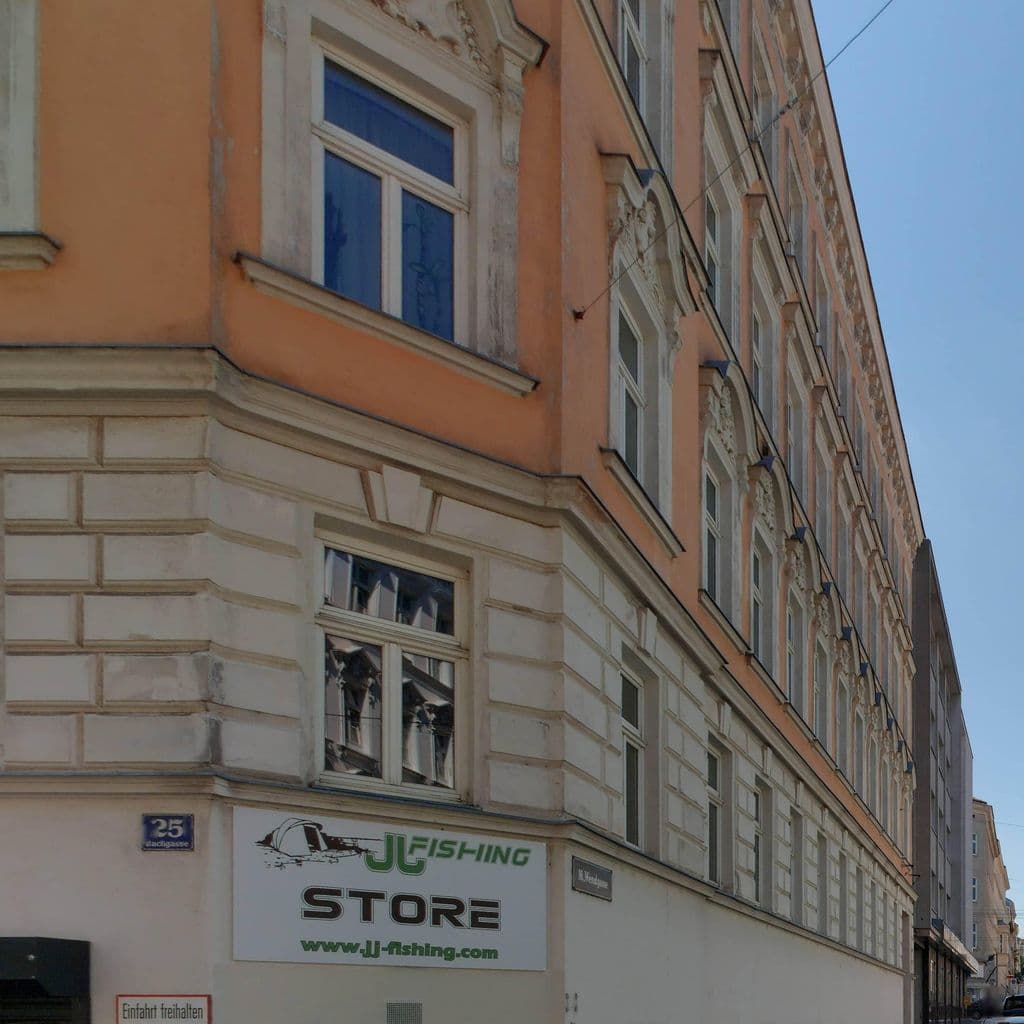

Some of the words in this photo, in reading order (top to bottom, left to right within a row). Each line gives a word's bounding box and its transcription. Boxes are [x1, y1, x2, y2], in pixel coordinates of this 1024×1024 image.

[151, 819, 184, 838] 25
[407, 836, 531, 867] FISHING
[302, 887, 501, 931] STORE
[300, 939, 499, 962] www.jj-fishing.com
[122, 1003, 157, 1019] Einfahrt
[160, 1003, 203, 1019] freihalten
